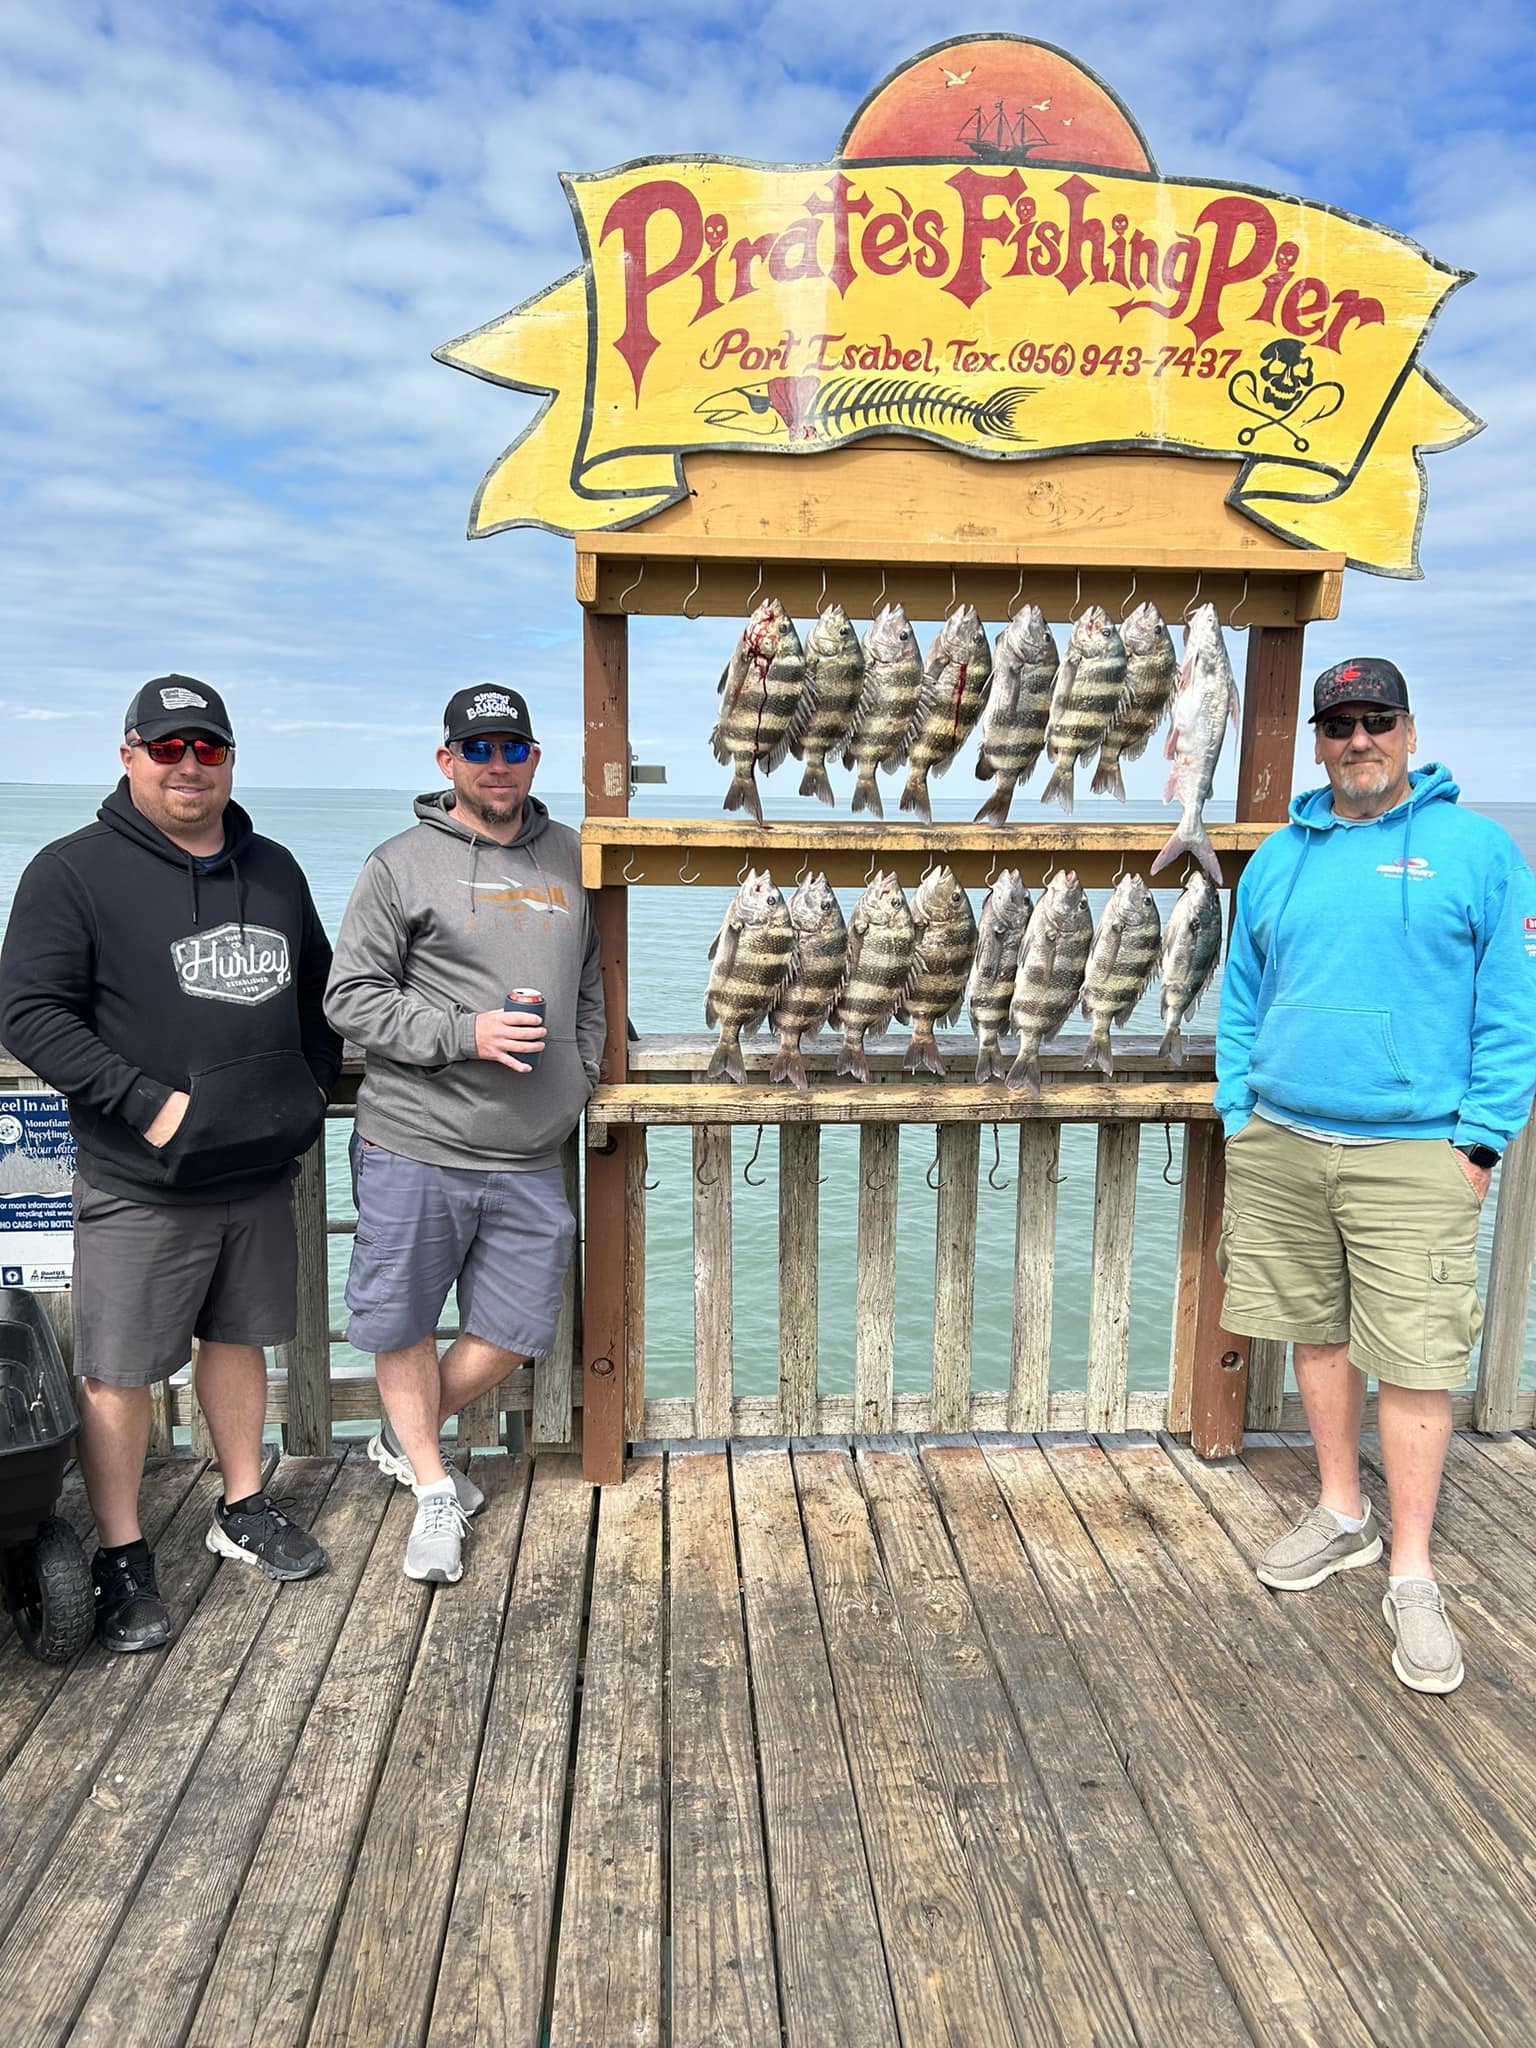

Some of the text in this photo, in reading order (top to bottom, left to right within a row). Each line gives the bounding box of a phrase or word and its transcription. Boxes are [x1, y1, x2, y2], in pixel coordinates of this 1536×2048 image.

[599, 166, 1386, 409] Pirate's Fishing Pier
[699, 328, 1243, 381] Port Isabel, Tex. (956) 943-7437
[181, 940, 289, 985] Hurley
[0, 1098, 21, 1112] eel
[23, 1099, 38, 1112] In
[40, 1101, 59, 1112] And
[28, 1201, 67, 1209] information
[51, 1220, 74, 1229] BOTTL
